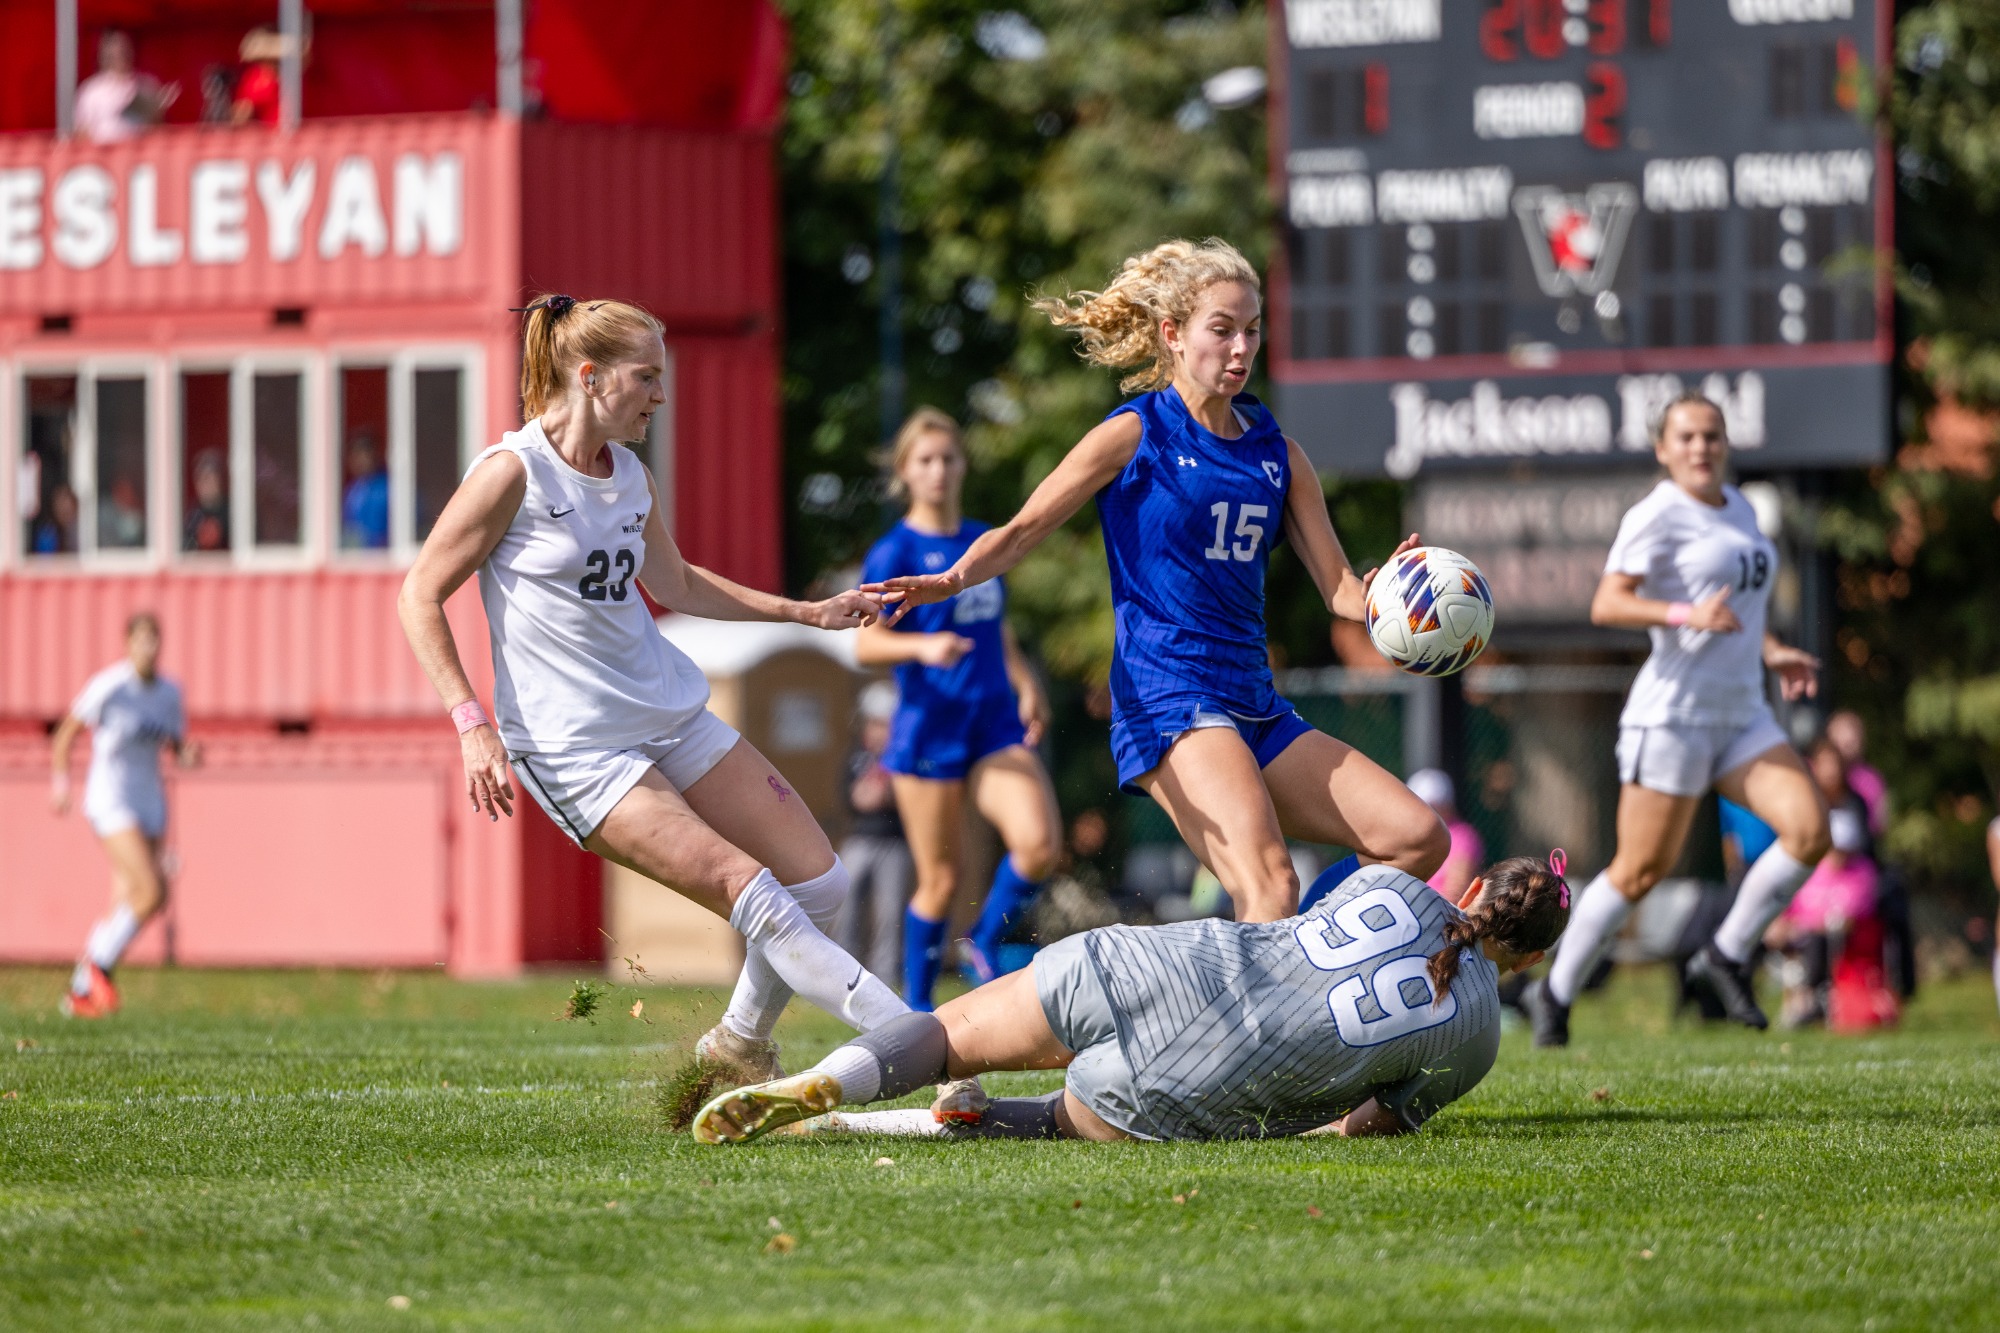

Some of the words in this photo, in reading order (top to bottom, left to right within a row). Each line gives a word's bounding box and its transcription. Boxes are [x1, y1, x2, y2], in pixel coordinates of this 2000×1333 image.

[0, 151, 462, 269] ESLEYAN
[1385, 379, 1611, 479] Jackson
[1205, 501, 1269, 562] 15
[1738, 549, 1768, 592] 18
[578, 549, 635, 601] 23
[1294, 887, 1458, 1048] 99
